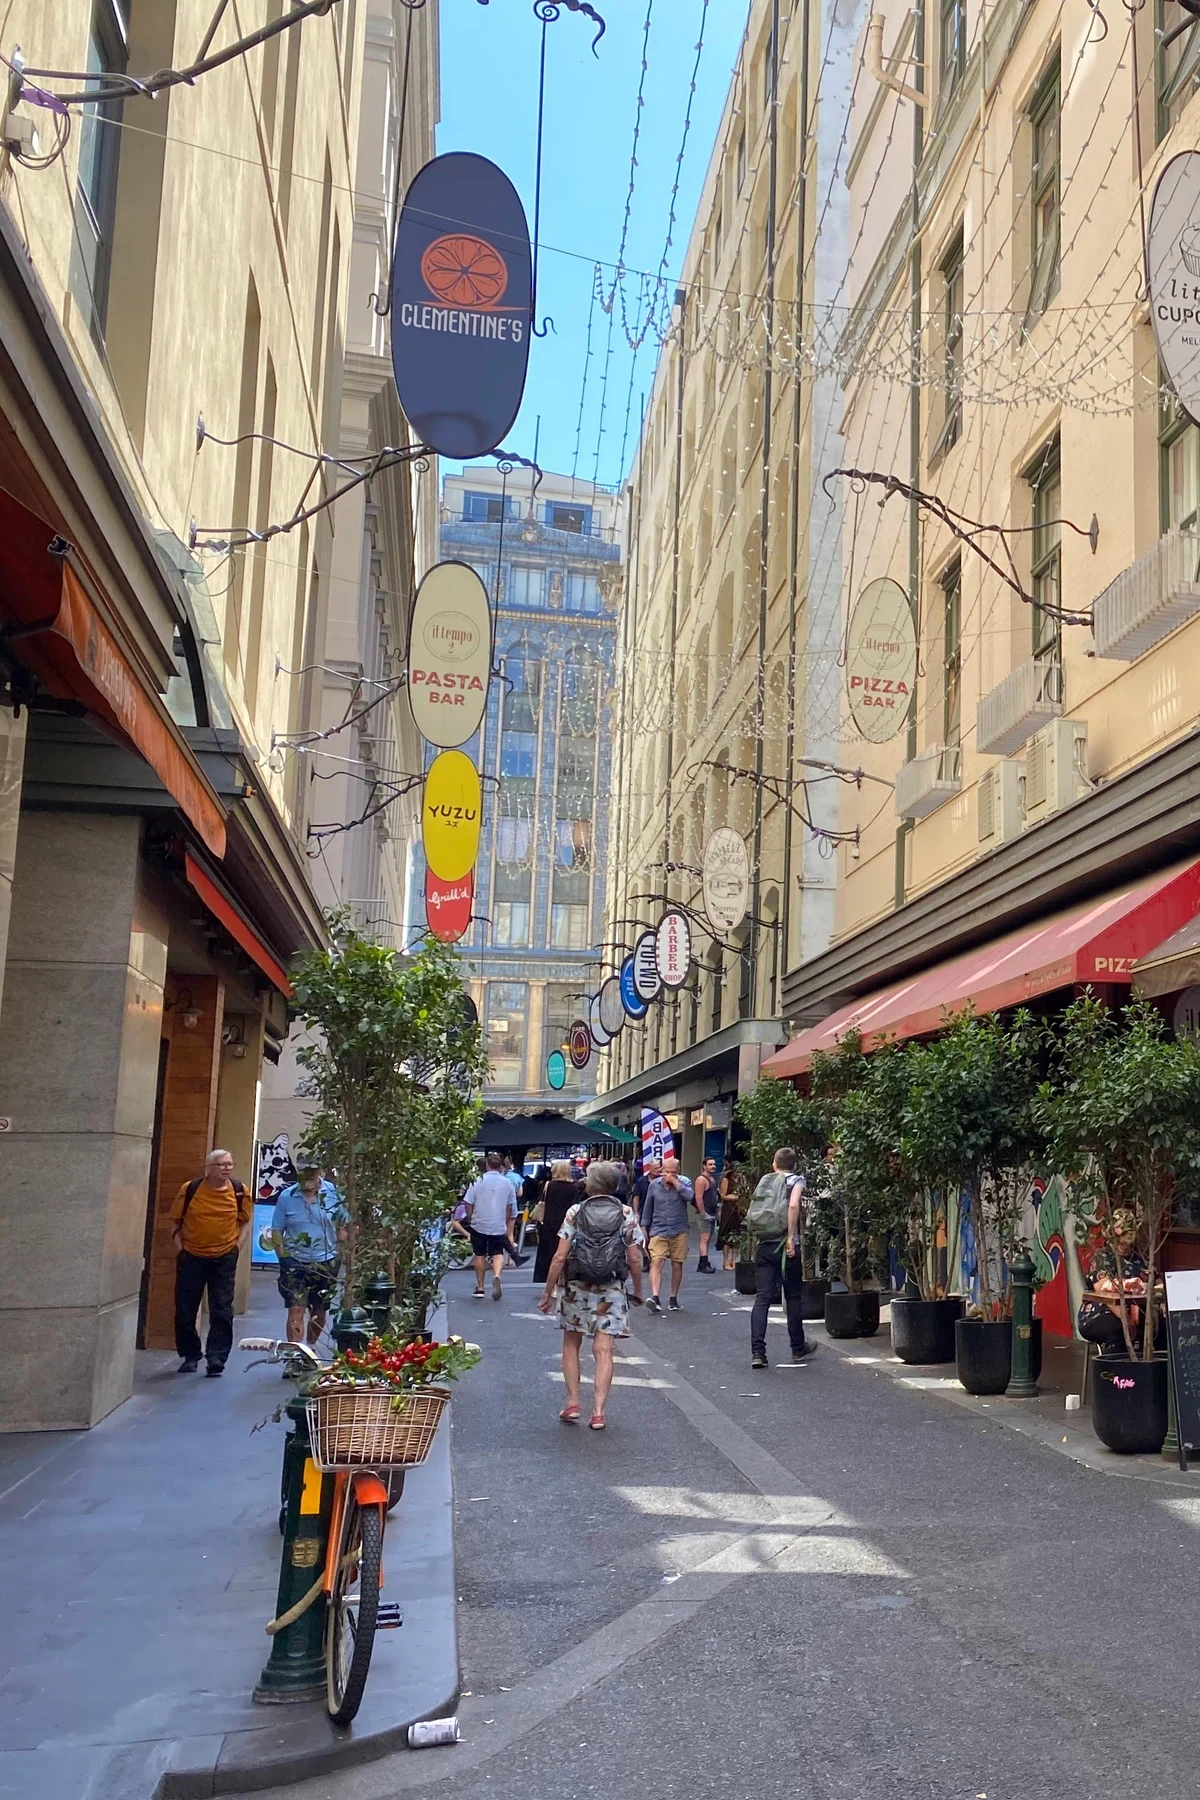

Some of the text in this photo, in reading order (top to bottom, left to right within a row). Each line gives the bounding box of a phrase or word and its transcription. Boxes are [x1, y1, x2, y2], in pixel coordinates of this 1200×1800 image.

[401, 303, 523, 342] CLEMENTINE'S
[432, 625, 472, 645] il tempo
[412, 669, 484, 692] PASTA
[850, 675, 909, 695] PIZZA
[429, 692, 465, 706] BAR
[863, 694, 895, 708] BAR
[428, 804, 476, 821] YUZU
[428, 887, 470, 909] Grill'd
[668, 917, 679, 971] BARBER
[1095, 957, 1138, 973] PIZZ
[1185, 1009, 1195, 1032] il
